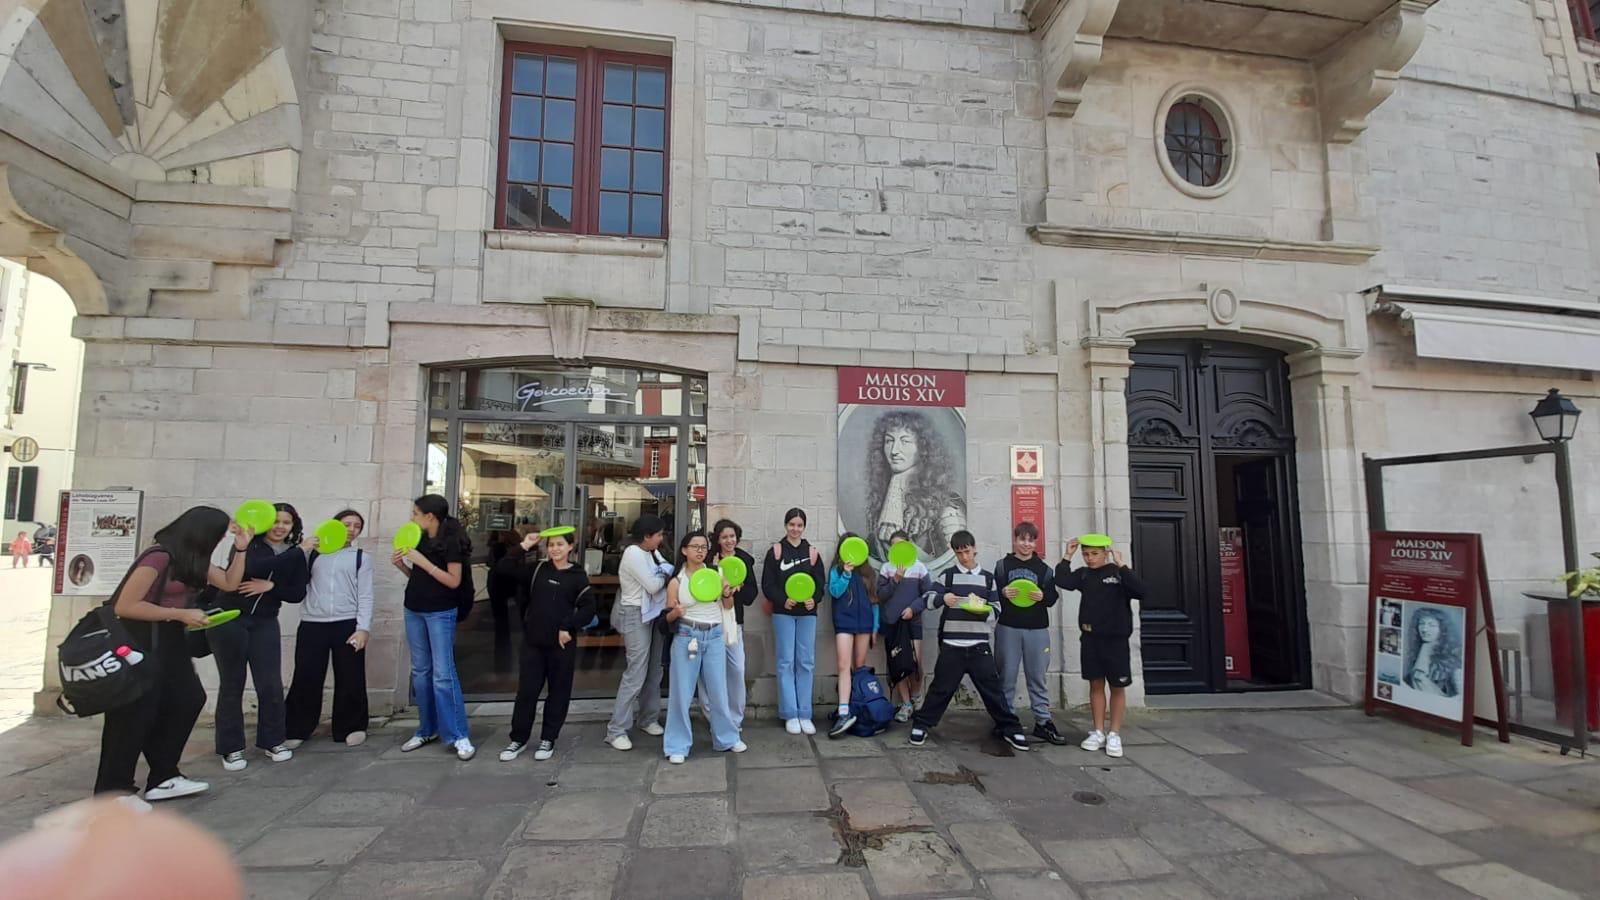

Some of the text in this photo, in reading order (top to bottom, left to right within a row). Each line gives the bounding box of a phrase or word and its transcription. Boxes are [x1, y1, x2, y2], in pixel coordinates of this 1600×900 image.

[865, 373, 936, 387] MAISON
[858, 386, 946, 402] LOUIS XIV
[1395, 539, 1446, 549] MAISON
[1391, 549, 1453, 561] LOUIS XIV
[60, 650, 122, 682] VANS
